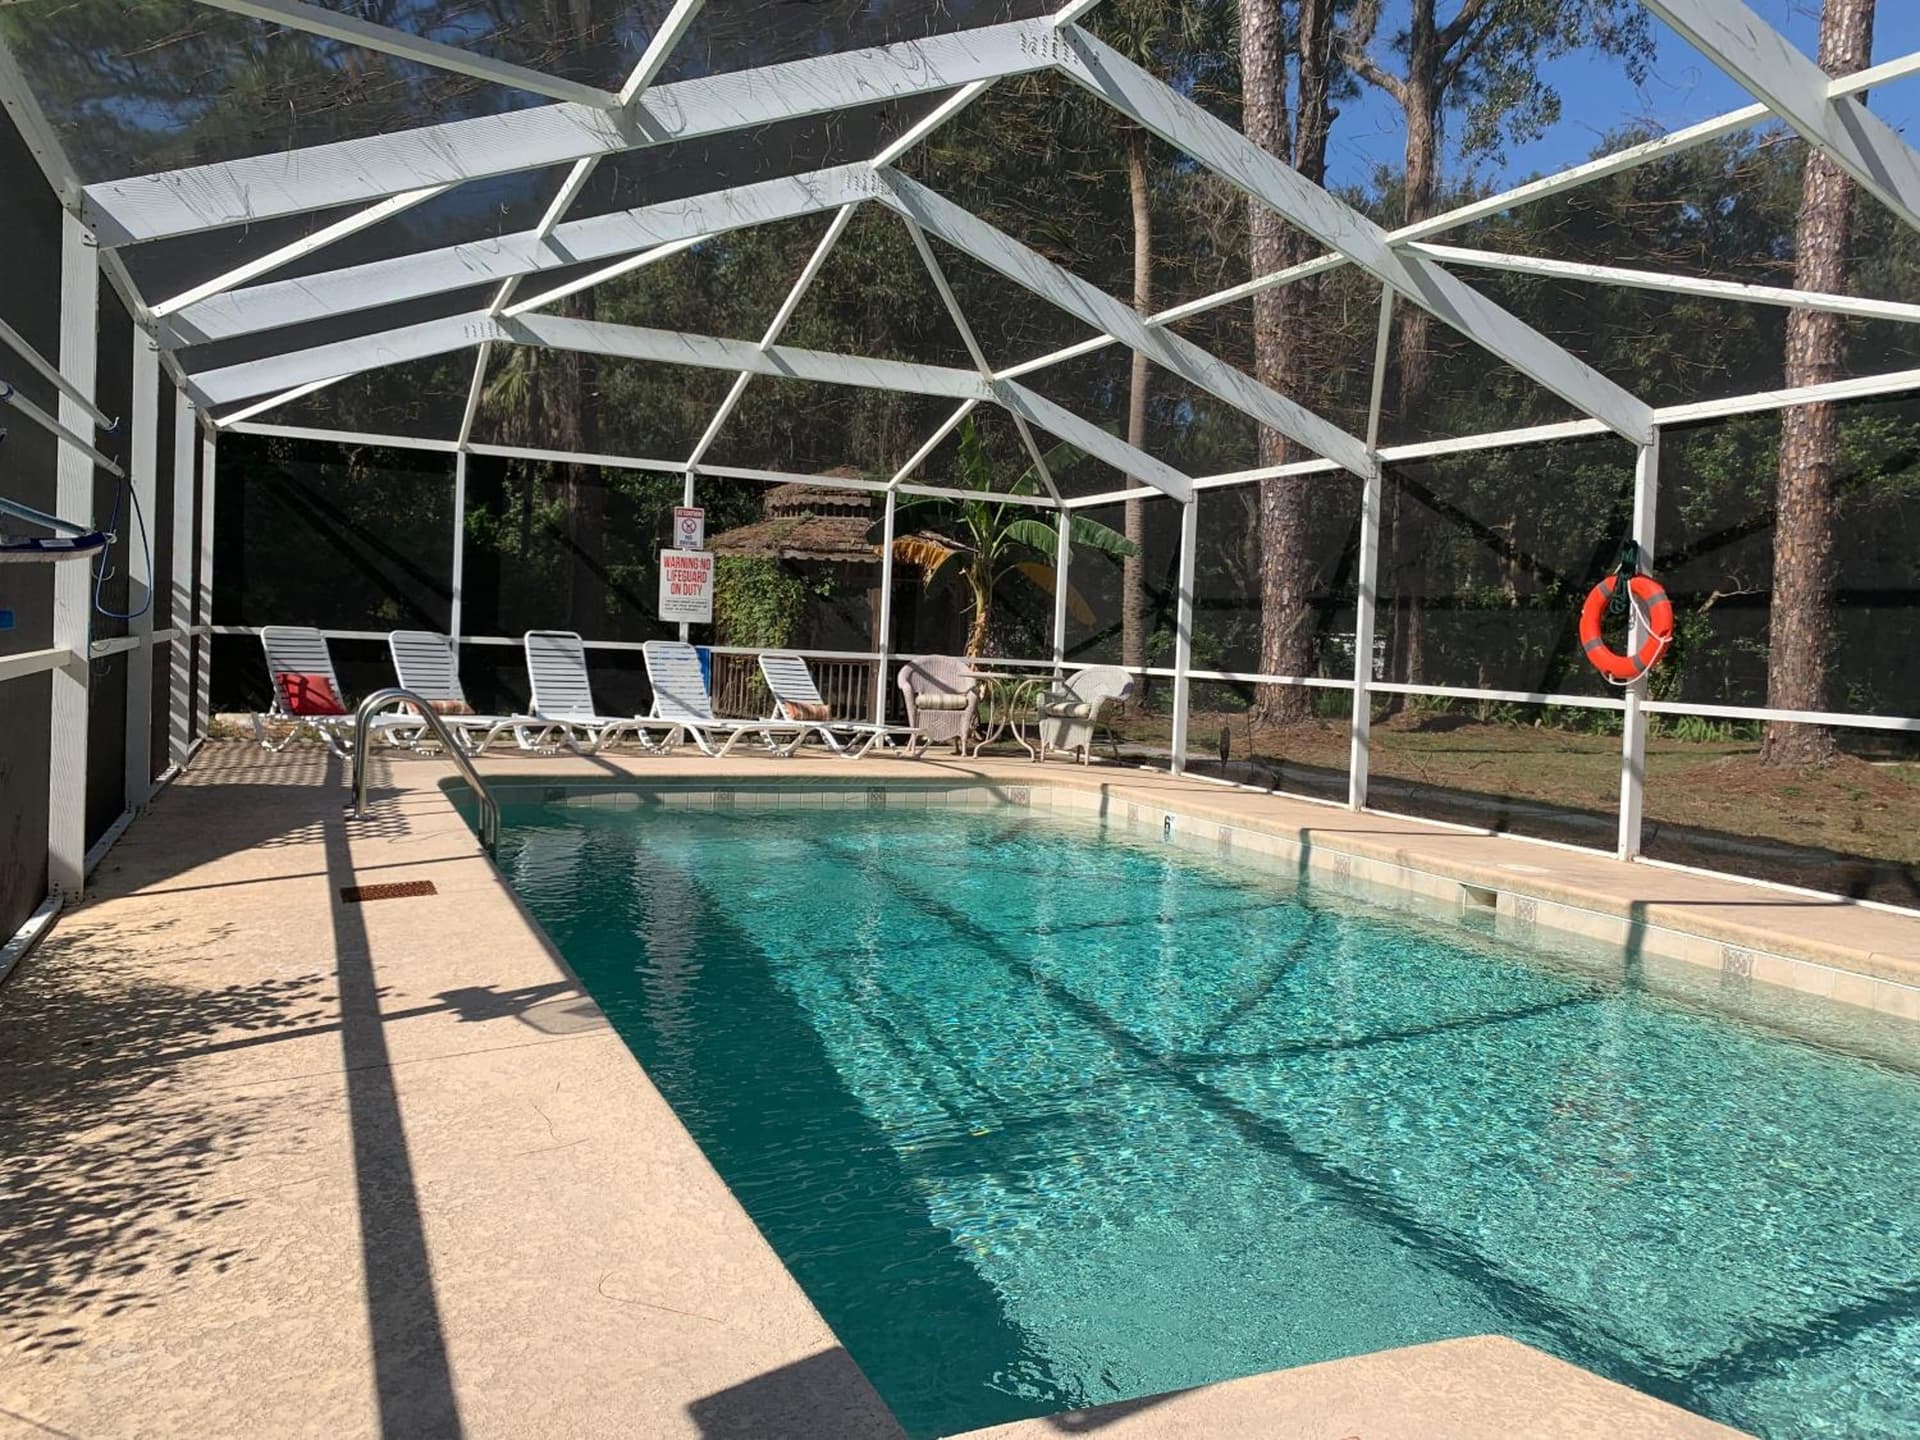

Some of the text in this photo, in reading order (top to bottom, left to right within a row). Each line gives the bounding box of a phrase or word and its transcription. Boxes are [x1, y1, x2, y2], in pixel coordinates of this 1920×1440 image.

[666, 569, 708, 584] LIFEGUARD
[671, 582, 703, 597] ON DUTY
